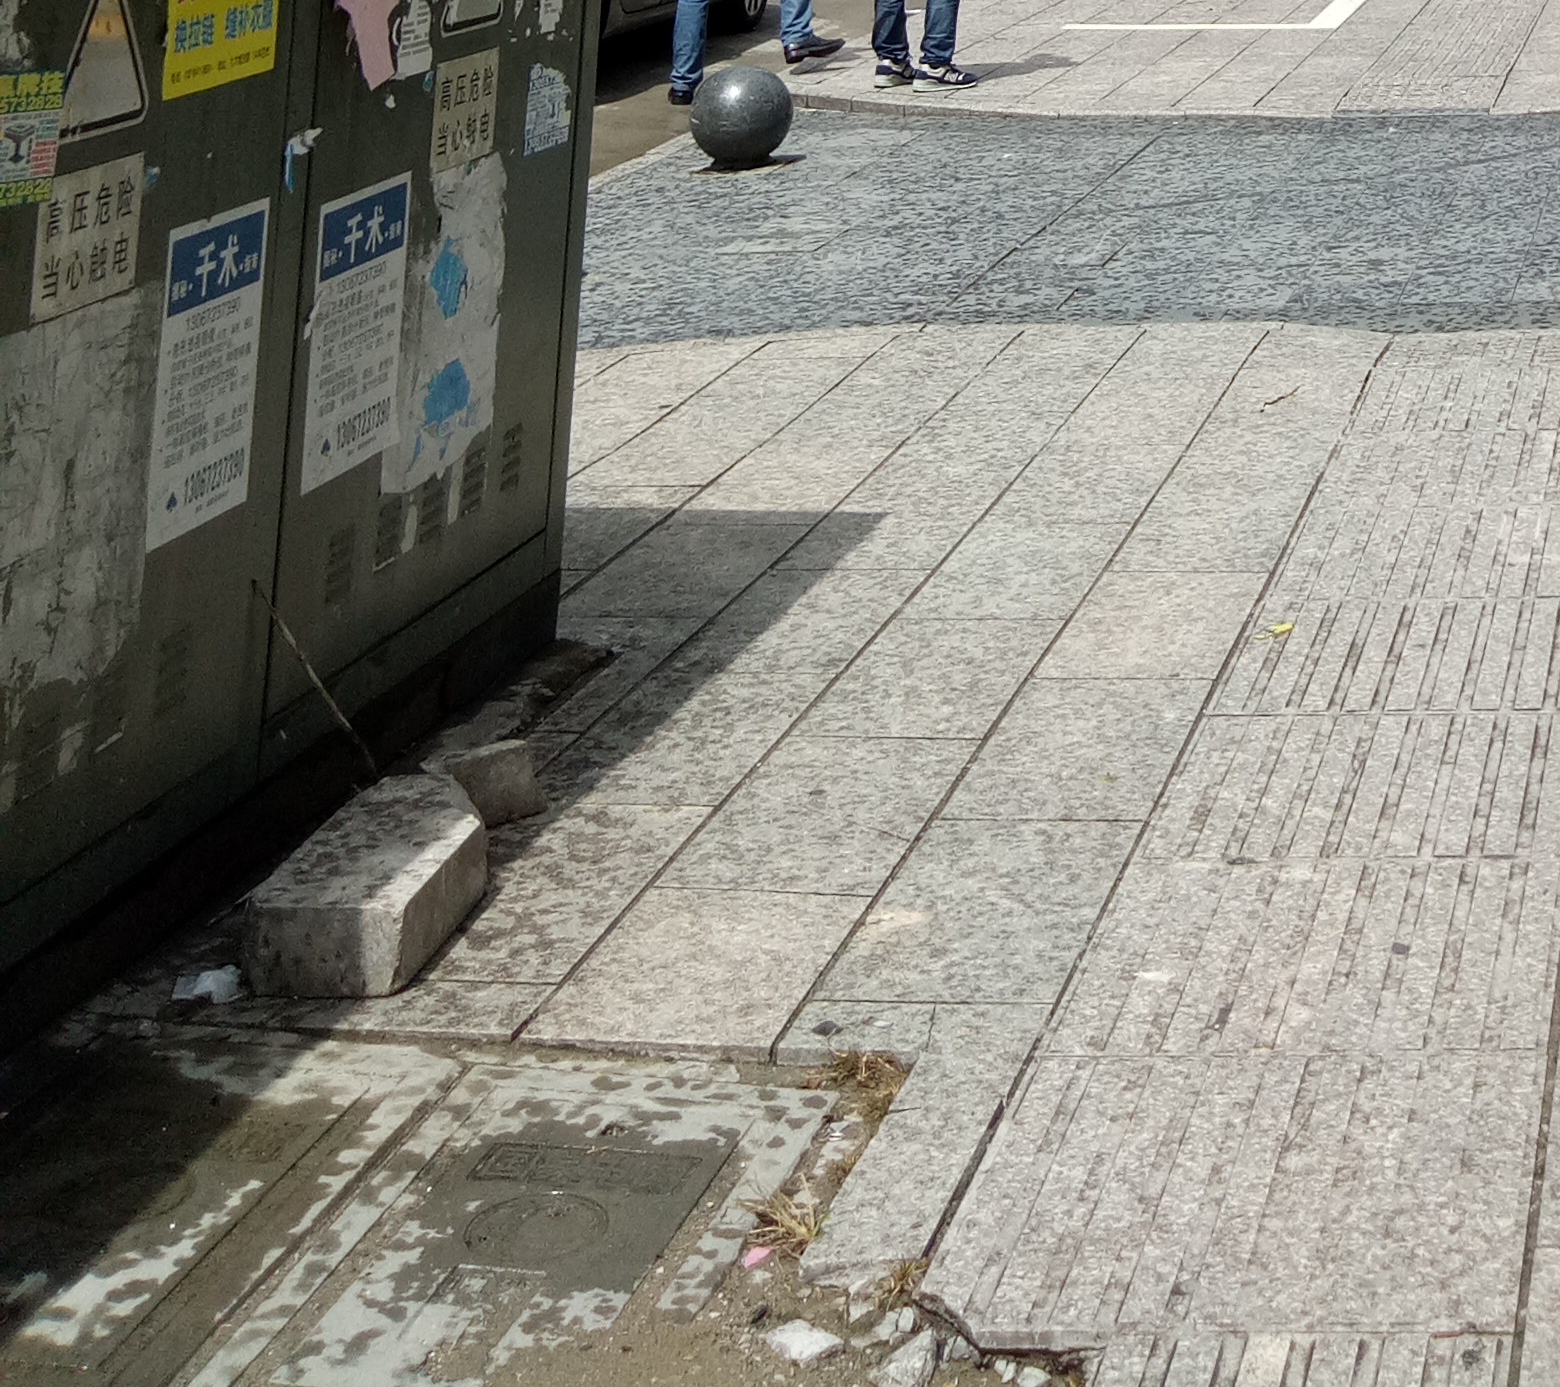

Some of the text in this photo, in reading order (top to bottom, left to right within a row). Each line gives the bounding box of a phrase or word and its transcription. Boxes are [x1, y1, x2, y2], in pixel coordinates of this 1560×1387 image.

[439, 64, 494, 113] 高压危险
[45, 174, 135, 245] 高压危险
[343, 204, 385, 264] 千术
[41, 231, 131, 301] 当心触电
[194, 233, 240, 298] 千术
